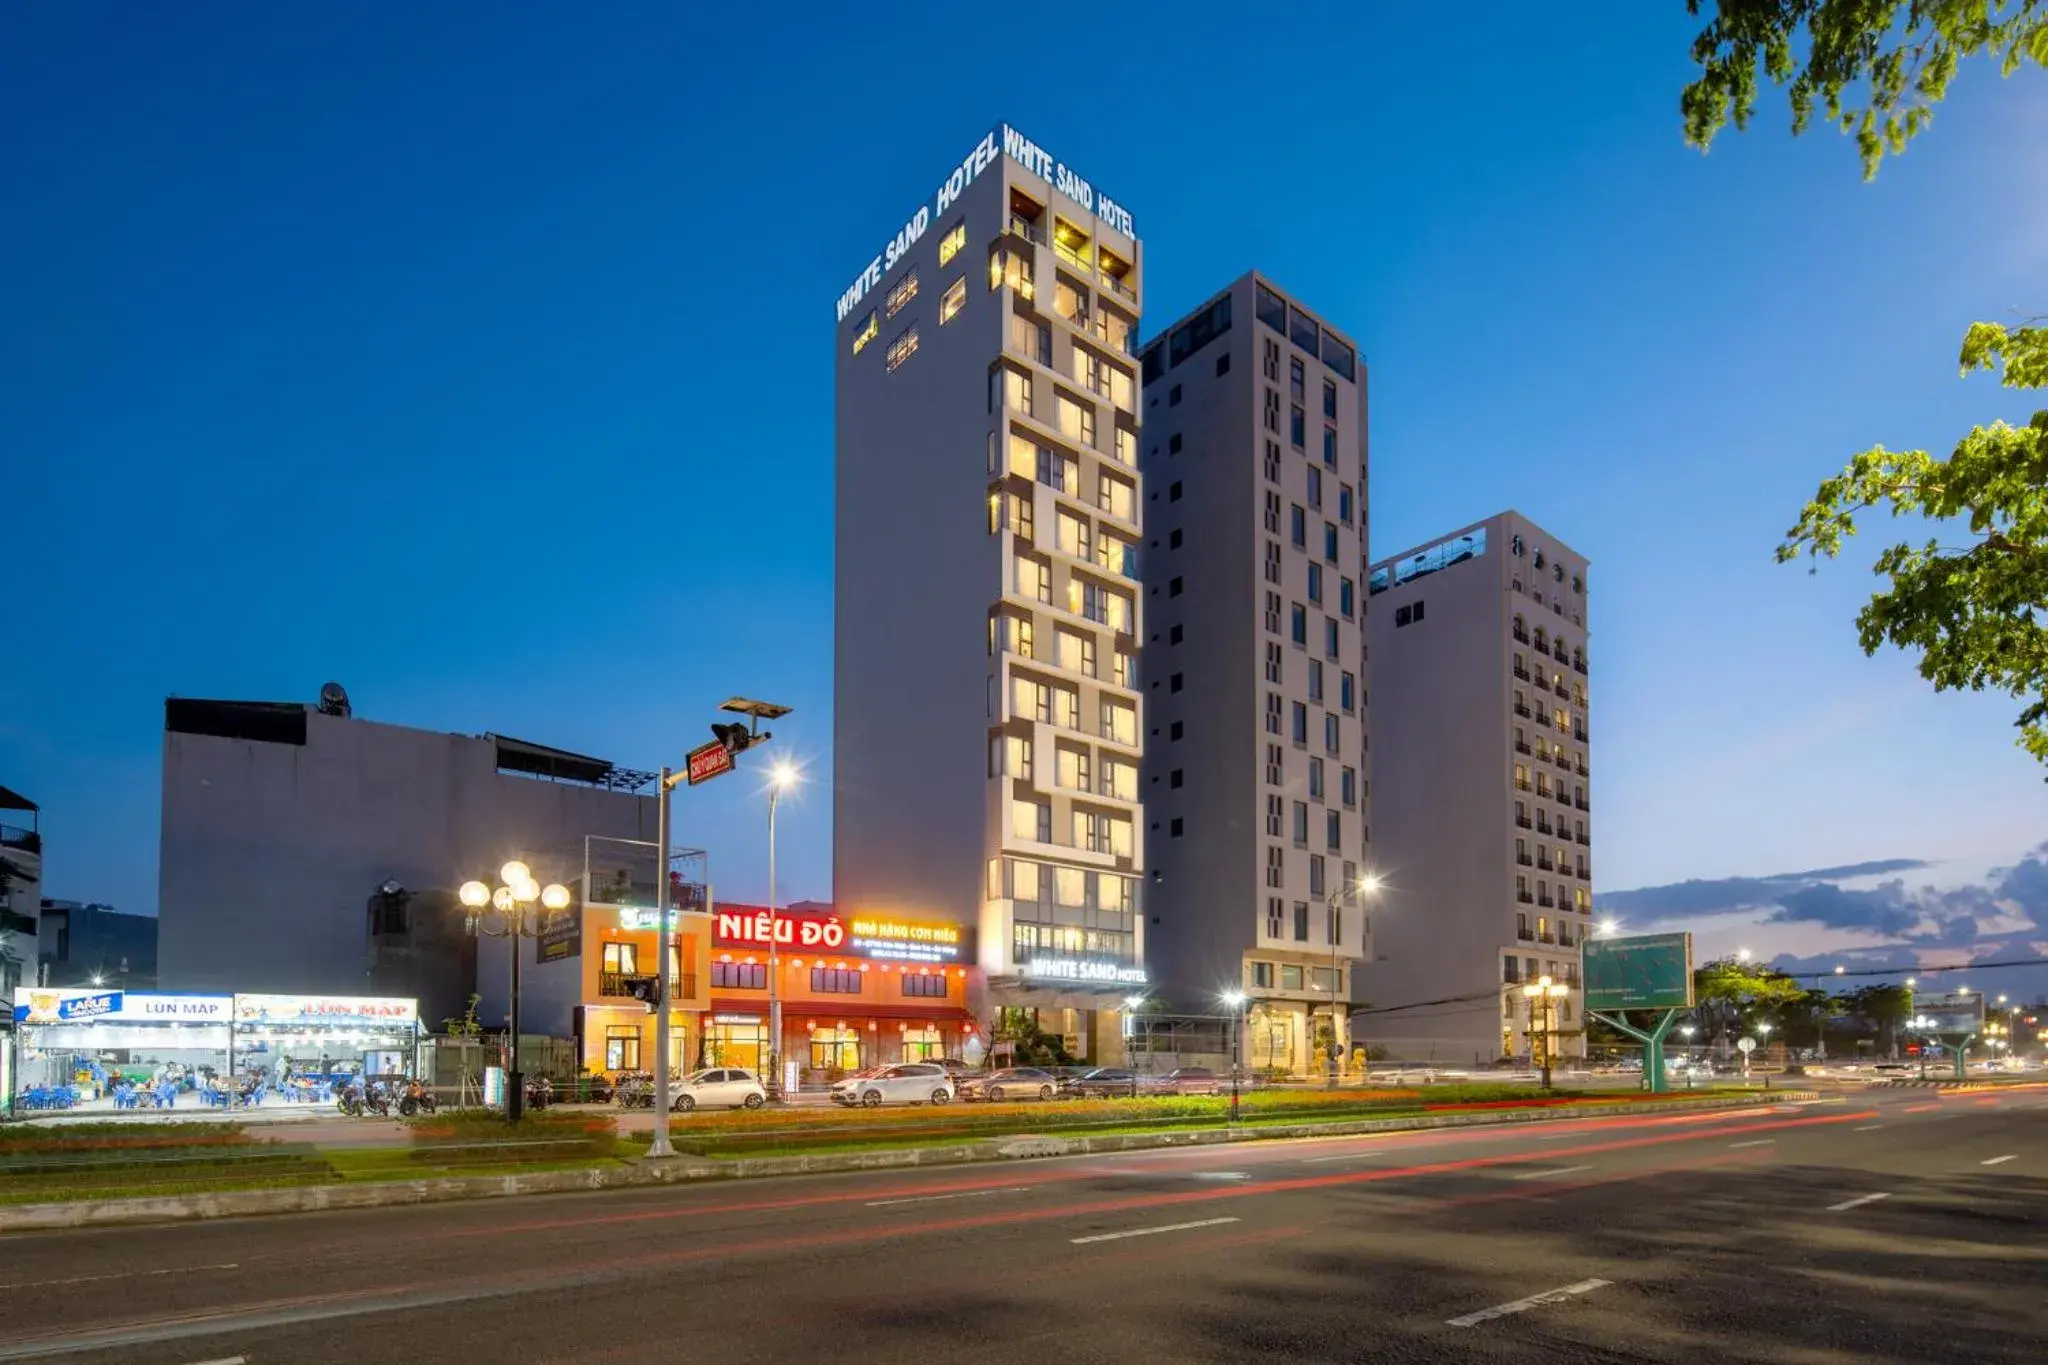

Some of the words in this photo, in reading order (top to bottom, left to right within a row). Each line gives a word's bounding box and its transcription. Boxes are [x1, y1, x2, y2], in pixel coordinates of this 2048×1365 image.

[1003, 123, 1054, 185] WHITE
[1056, 162, 1093, 209] SAND
[1098, 192, 1136, 239] HOTEL
[836, 255, 882, 323] WHITE
[885, 205, 929, 272] SAND
[936, 131, 999, 217] HOTEL
[719, 911, 793, 943] NIÊU
[800, 916, 844, 947] ĐỎ
[1032, 959, 1077, 978] WHITE
[1079, 962, 1116, 981] SAND
[1117, 969, 1147, 983] HOTEL
